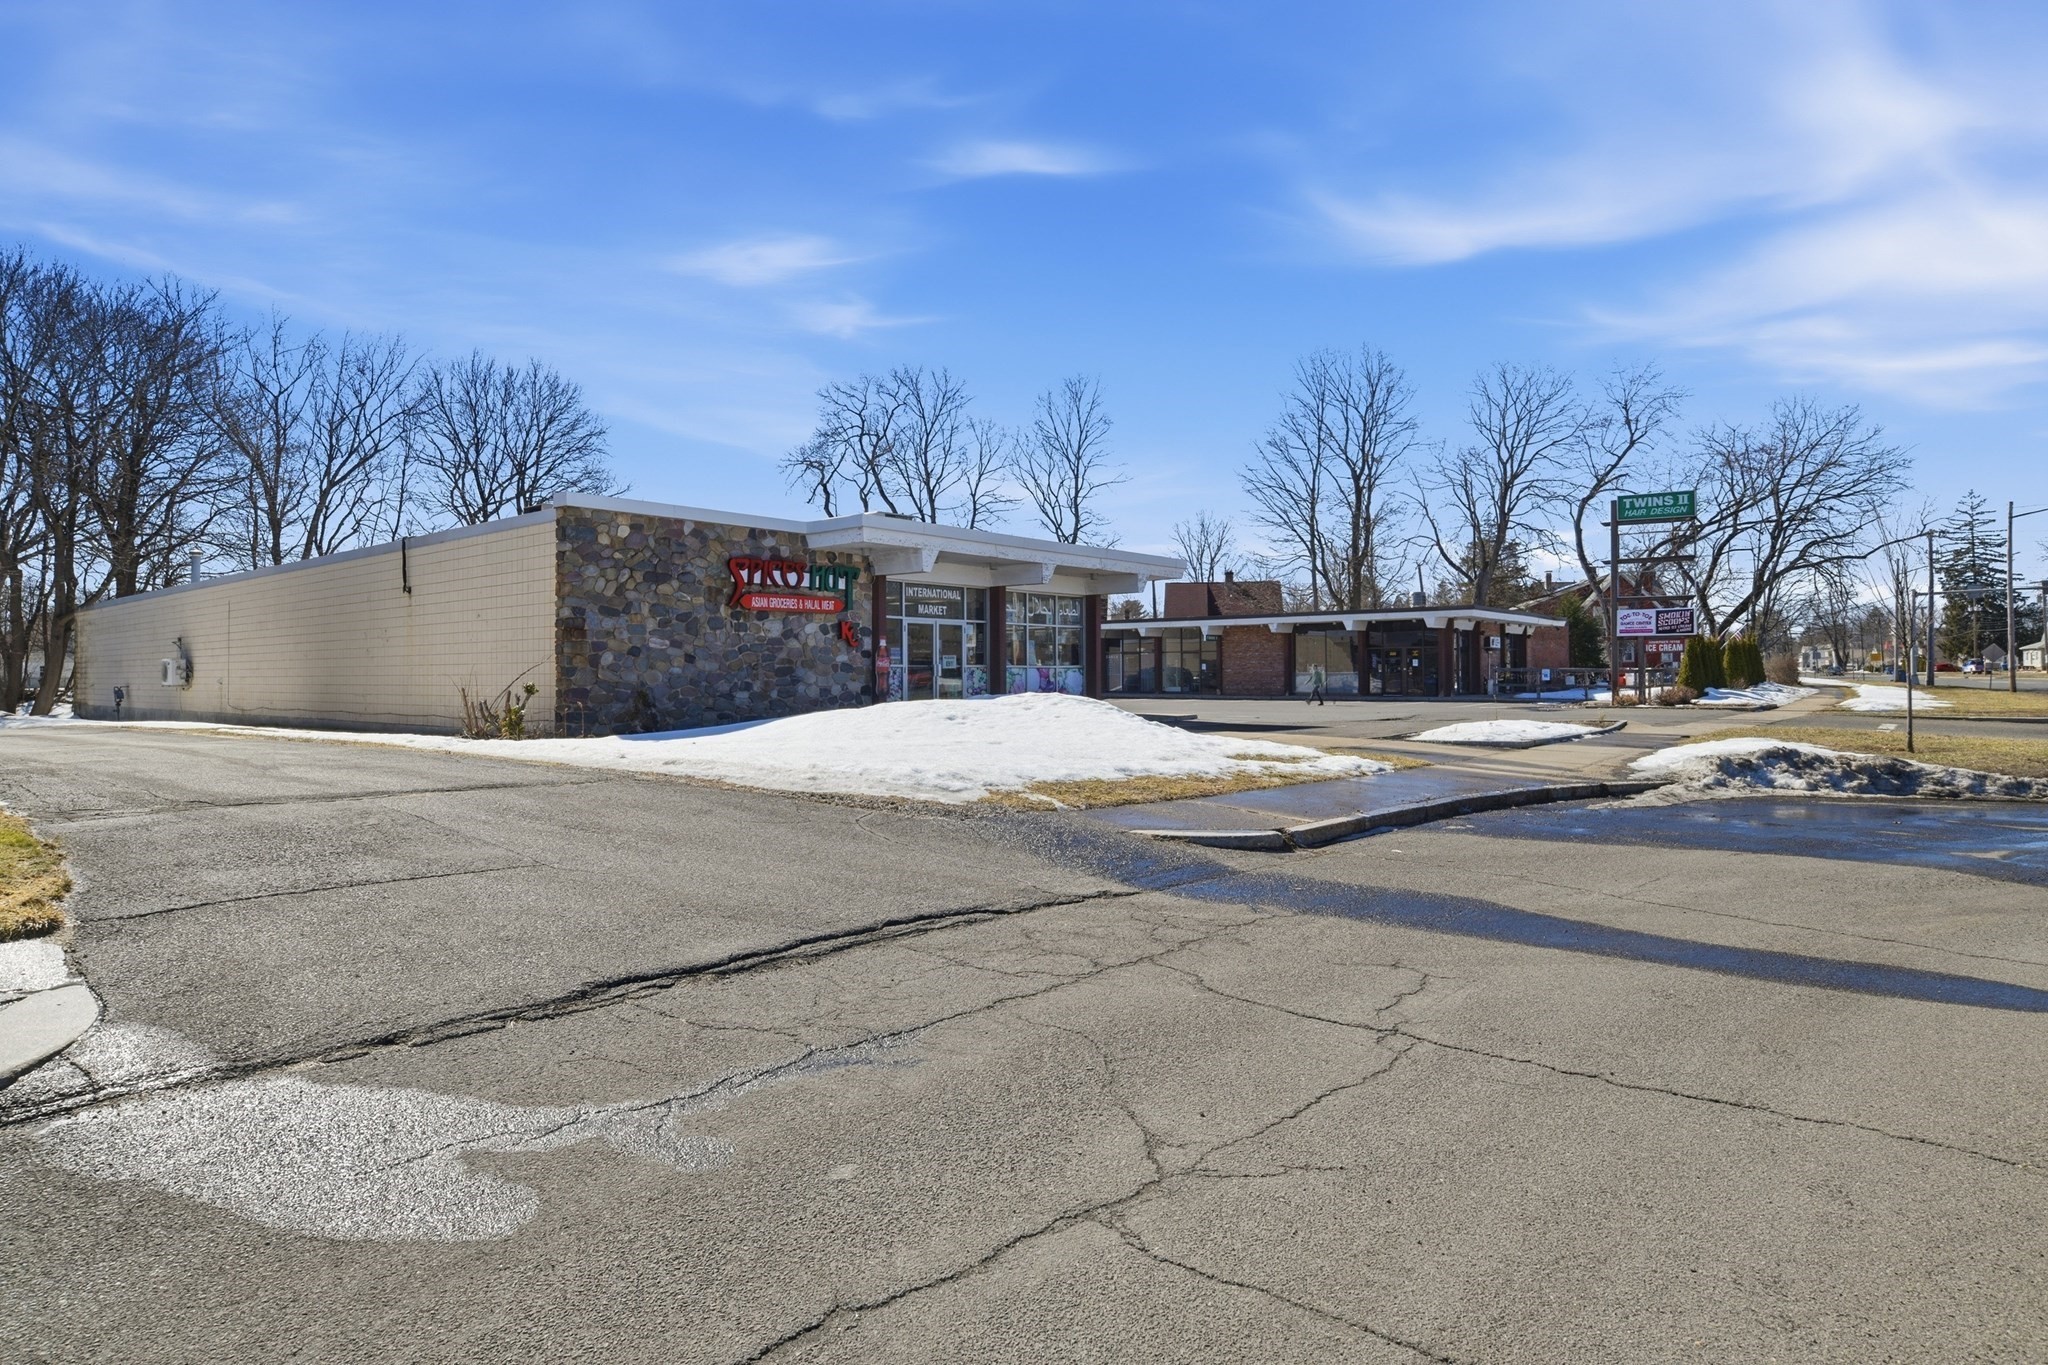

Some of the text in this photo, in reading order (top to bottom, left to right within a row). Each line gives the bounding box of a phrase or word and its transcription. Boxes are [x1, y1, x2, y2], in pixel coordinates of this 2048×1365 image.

[1624, 495, 1689, 508] TWINS II
[1625, 506, 1687, 517] HAIR DESIGN
[729, 557, 861, 612] SPICES HUT
[905, 586, 961, 600] INTERNATIONAL
[751, 596, 835, 611] ASIAN GROCERIES & HALAL MEAT
[918, 604, 947, 616] MARKET
[1659, 644, 1683, 652] CREAM
